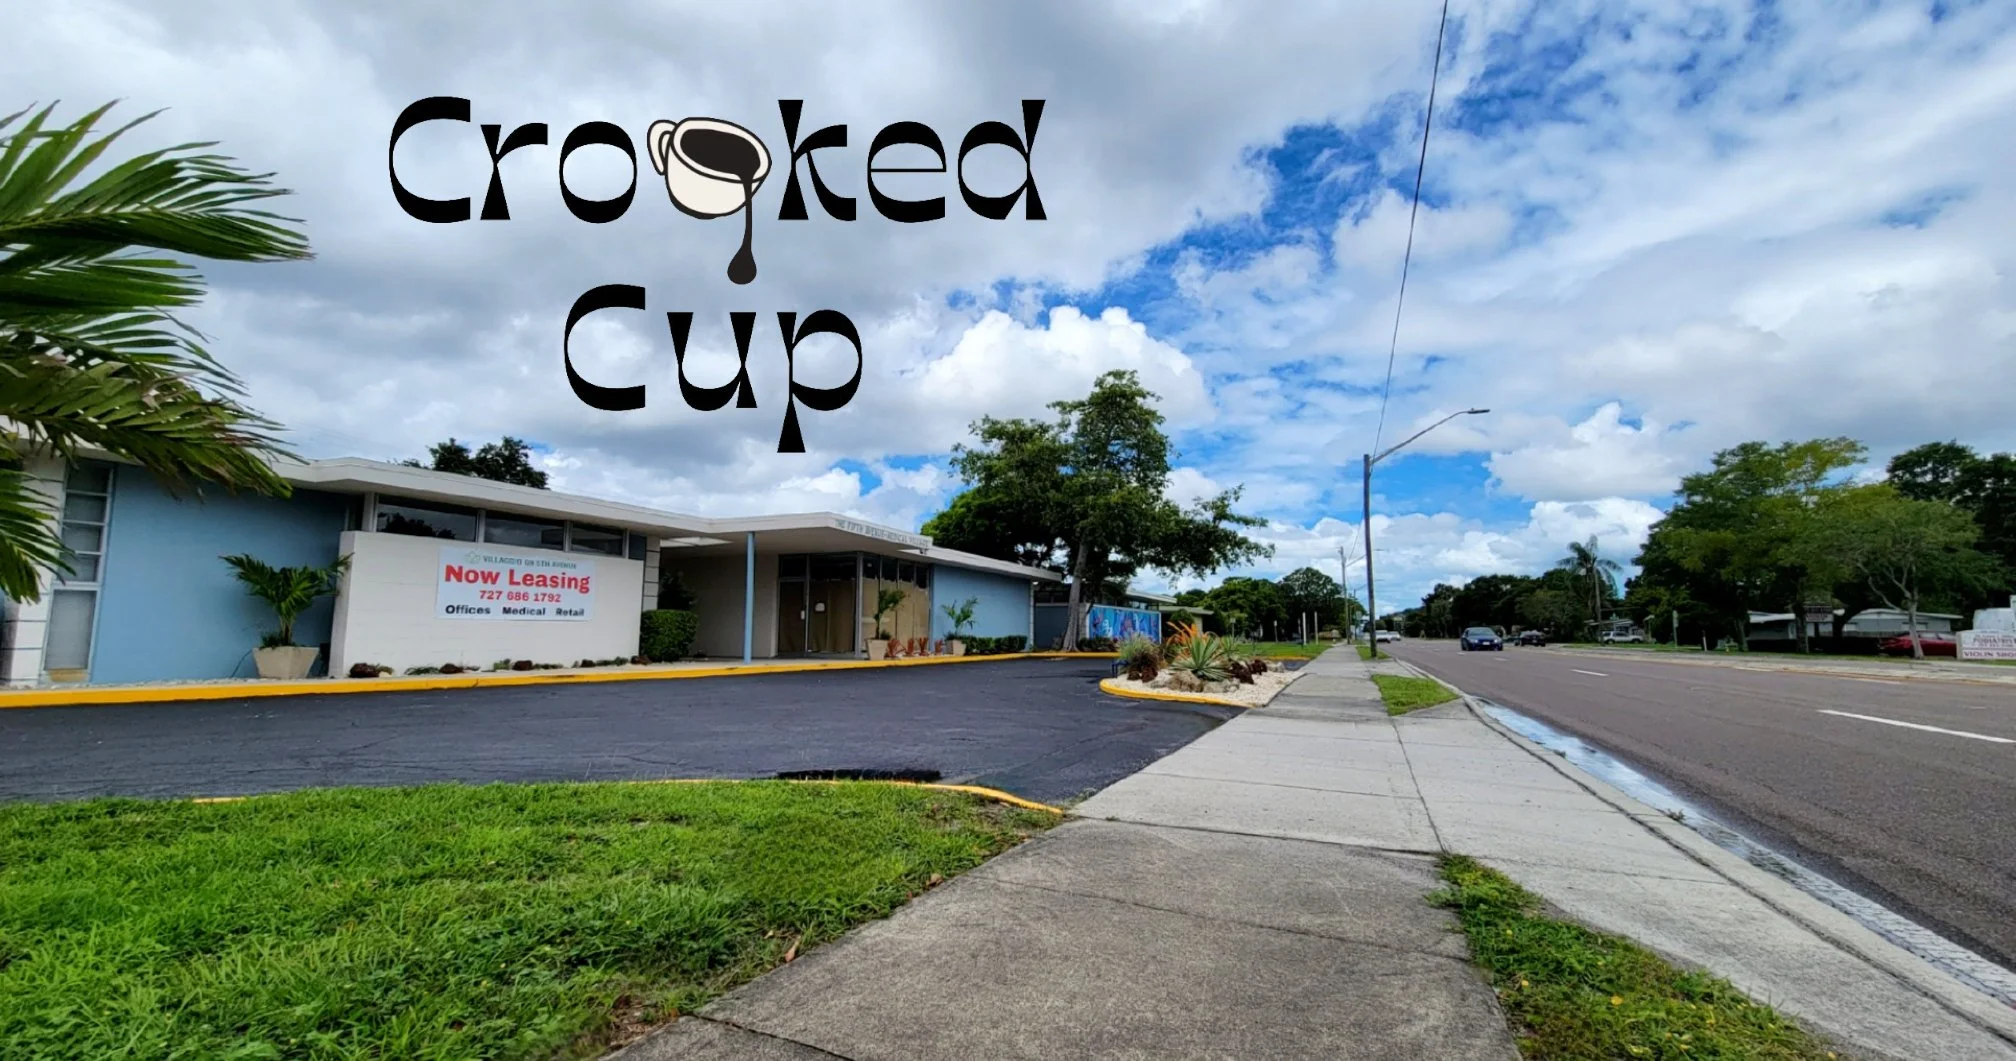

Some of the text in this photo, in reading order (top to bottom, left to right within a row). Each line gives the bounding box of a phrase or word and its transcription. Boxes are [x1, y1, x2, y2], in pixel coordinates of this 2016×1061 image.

[445, 565, 590, 594] Now Leasing
[479, 590, 561, 602] 727 686 1792
[445, 604, 584, 617] Offices Medical Retail
